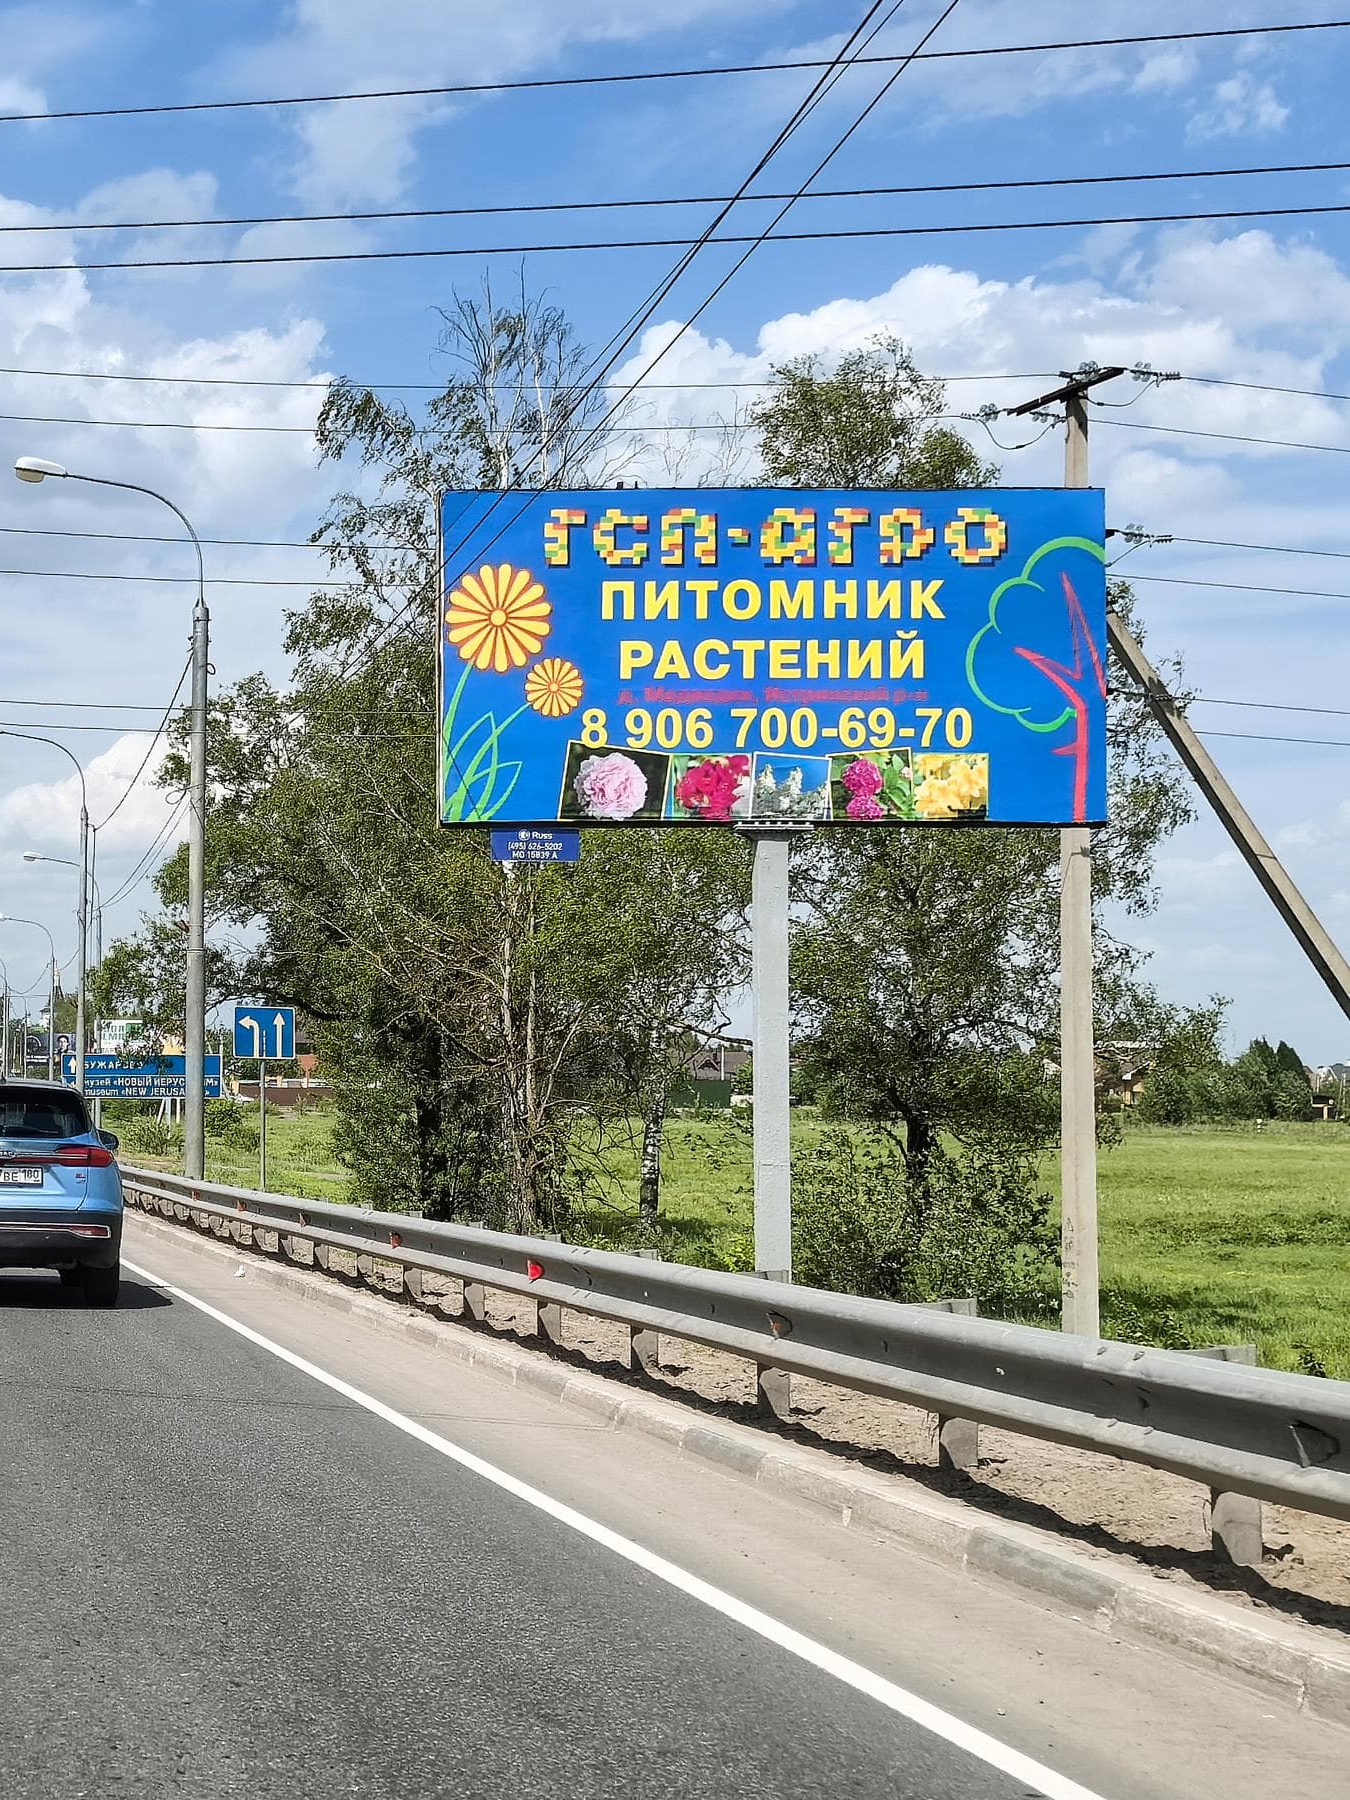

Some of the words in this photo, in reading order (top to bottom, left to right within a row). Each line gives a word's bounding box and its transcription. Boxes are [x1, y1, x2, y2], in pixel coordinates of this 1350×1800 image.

[544, 508, 1007, 567] ГСП-АГРО
[600, 579, 947, 620] ПИТОМНИК
[619, 629, 926, 680] РАСТЕНИЙ
[580, 707, 609, 748] 8
[623, 707, 714, 748] 906
[729, 707, 974, 748] 700-69-70
[508, 841, 527, 851] (495)
[531, 831, 554, 840] Russ
